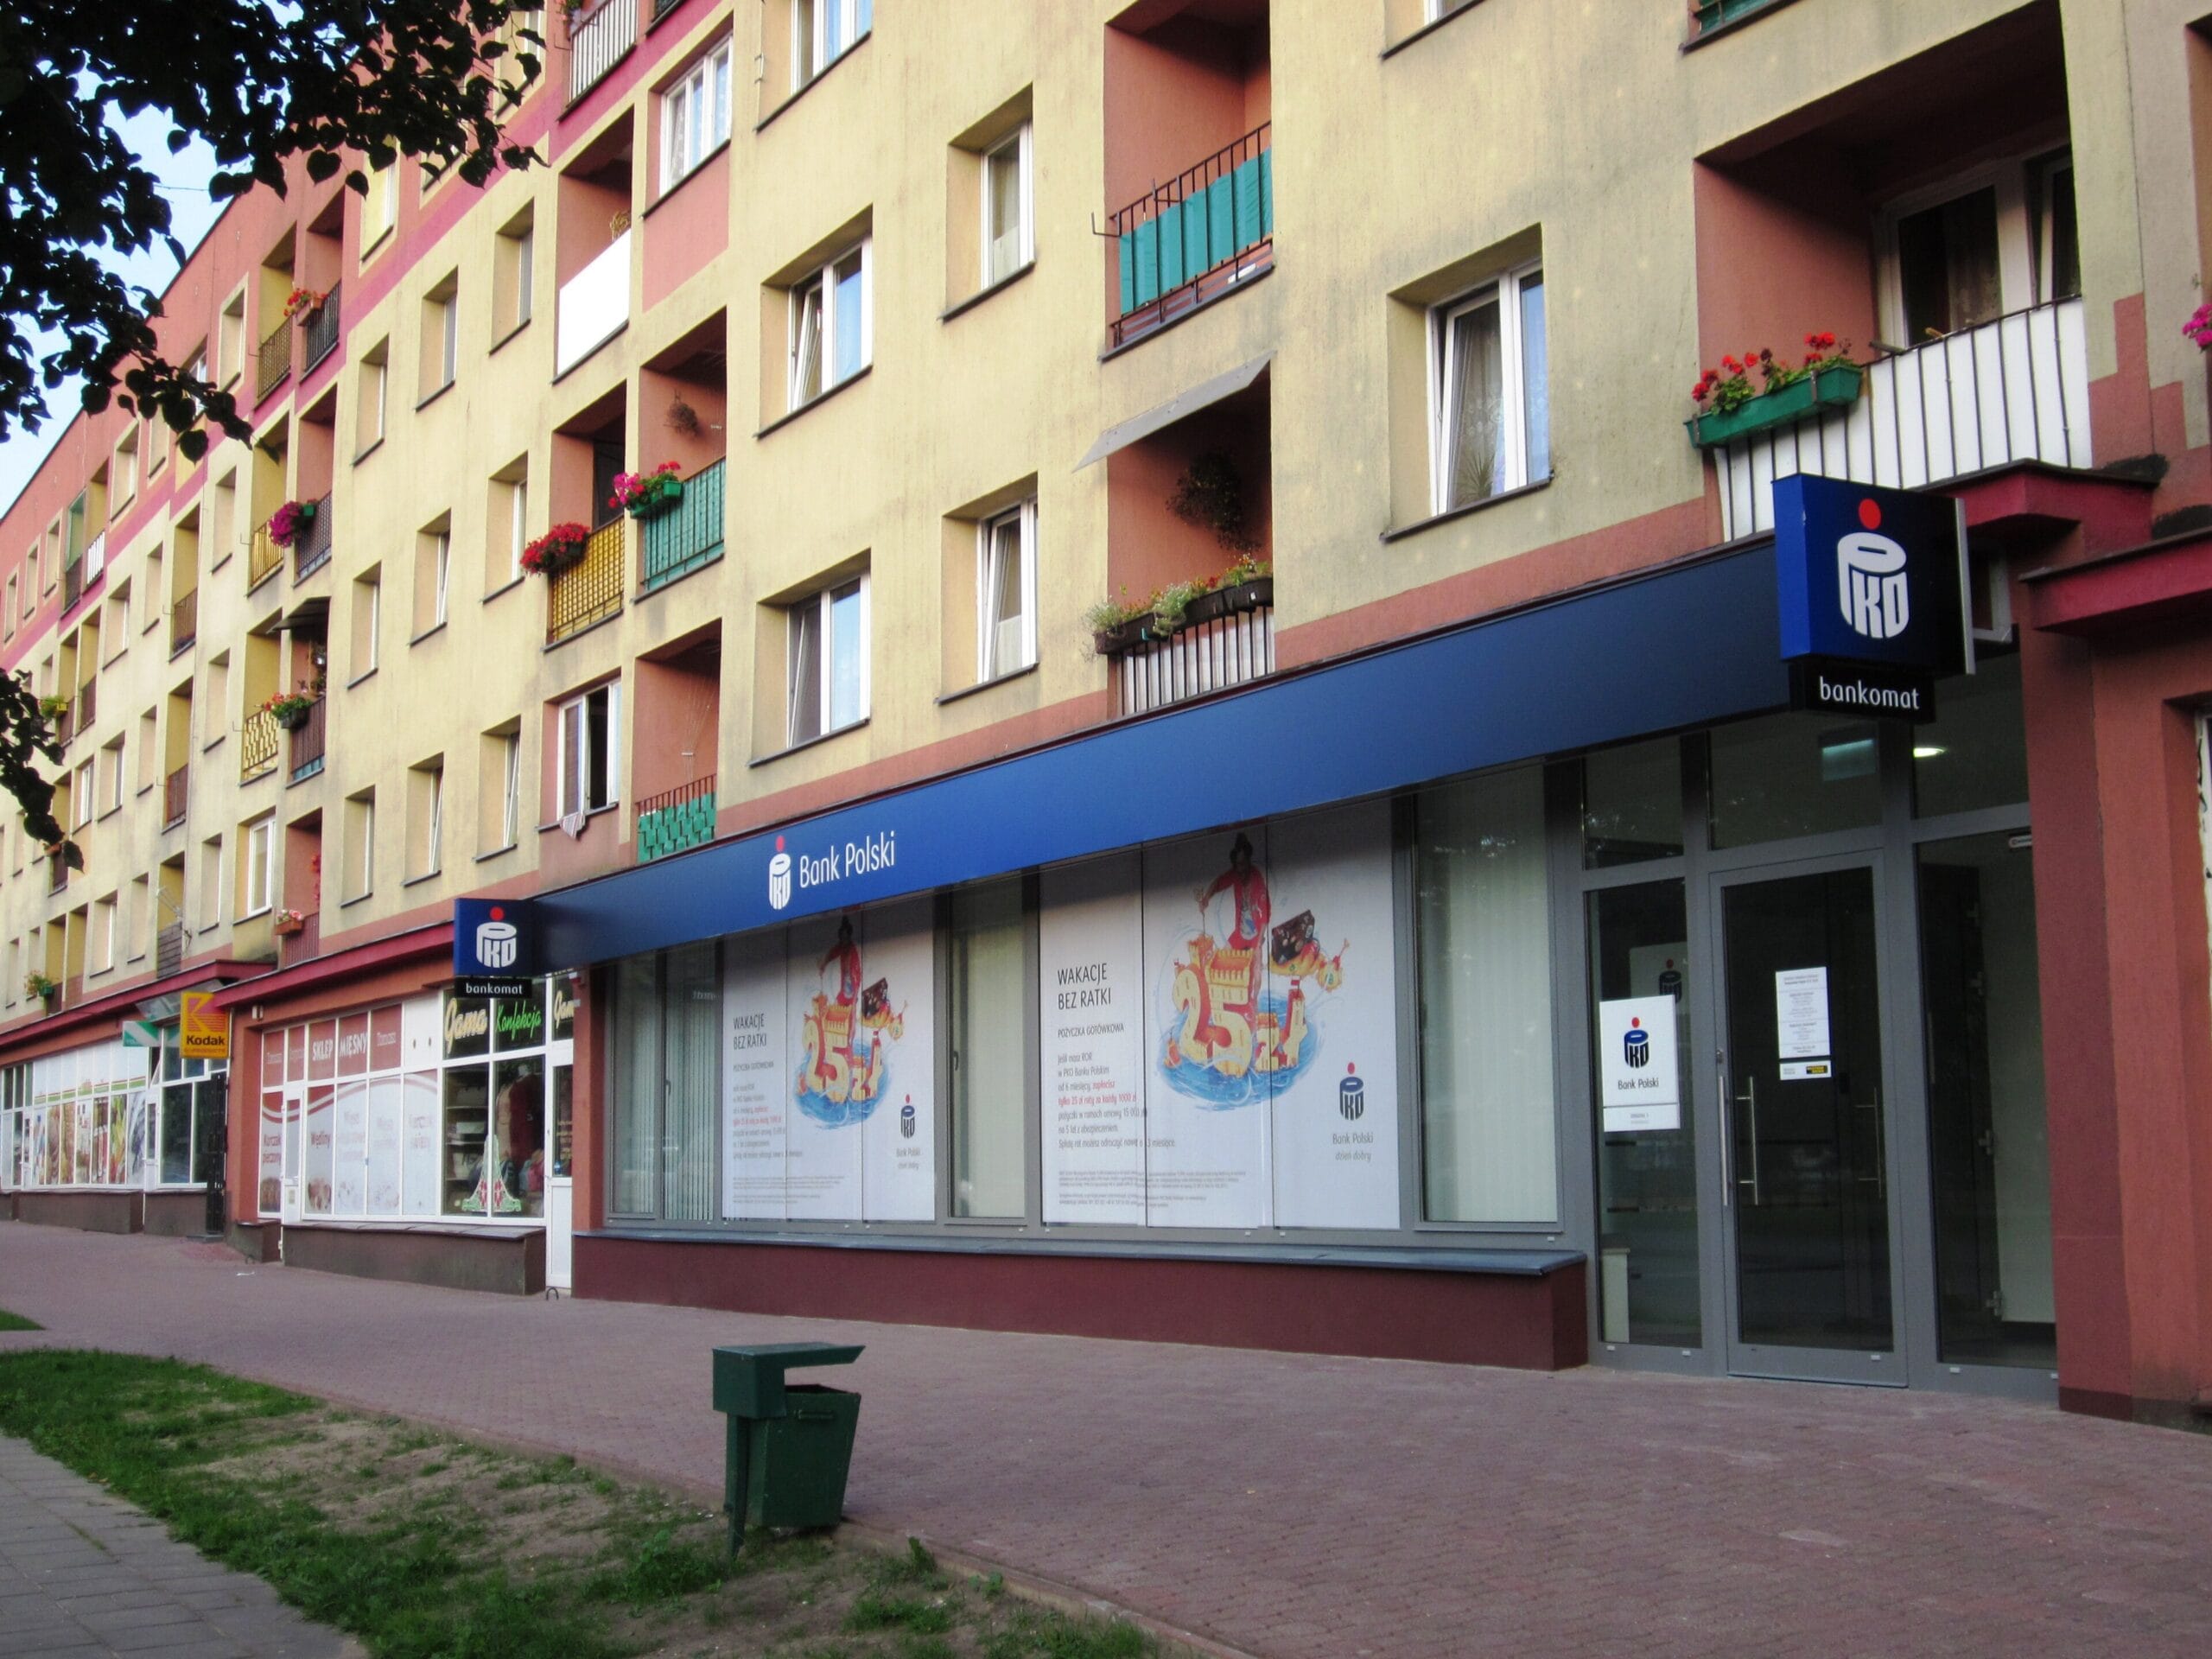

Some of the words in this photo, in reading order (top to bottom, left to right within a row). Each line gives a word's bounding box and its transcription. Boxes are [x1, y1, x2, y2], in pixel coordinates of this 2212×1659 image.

[1820, 676, 1920, 710] bankomat
[800, 845, 840, 888] Bank
[845, 830, 894, 877] Polski
[1058, 963, 1108, 985] WAKACJE
[466, 982, 523, 994] bankomat
[1058, 993, 1077, 1010] BEZ
[1080, 988, 1111, 1008] RATKI
[495, 1000, 542, 1040] Konfekcja
[734, 1014, 765, 1030] WAKACJE
[187, 1034, 226, 1046] Kodak
[734, 1036, 745, 1050] BEZ
[747, 1033, 766, 1048] RATKI
[313, 1039, 334, 1061] SKLEP
[1618, 1078, 1636, 1090] Bank
[1638, 1077, 1659, 1089] Polski
[1332, 1133, 1351, 1145] Bank
[1352, 1131, 1374, 1144] Polski
